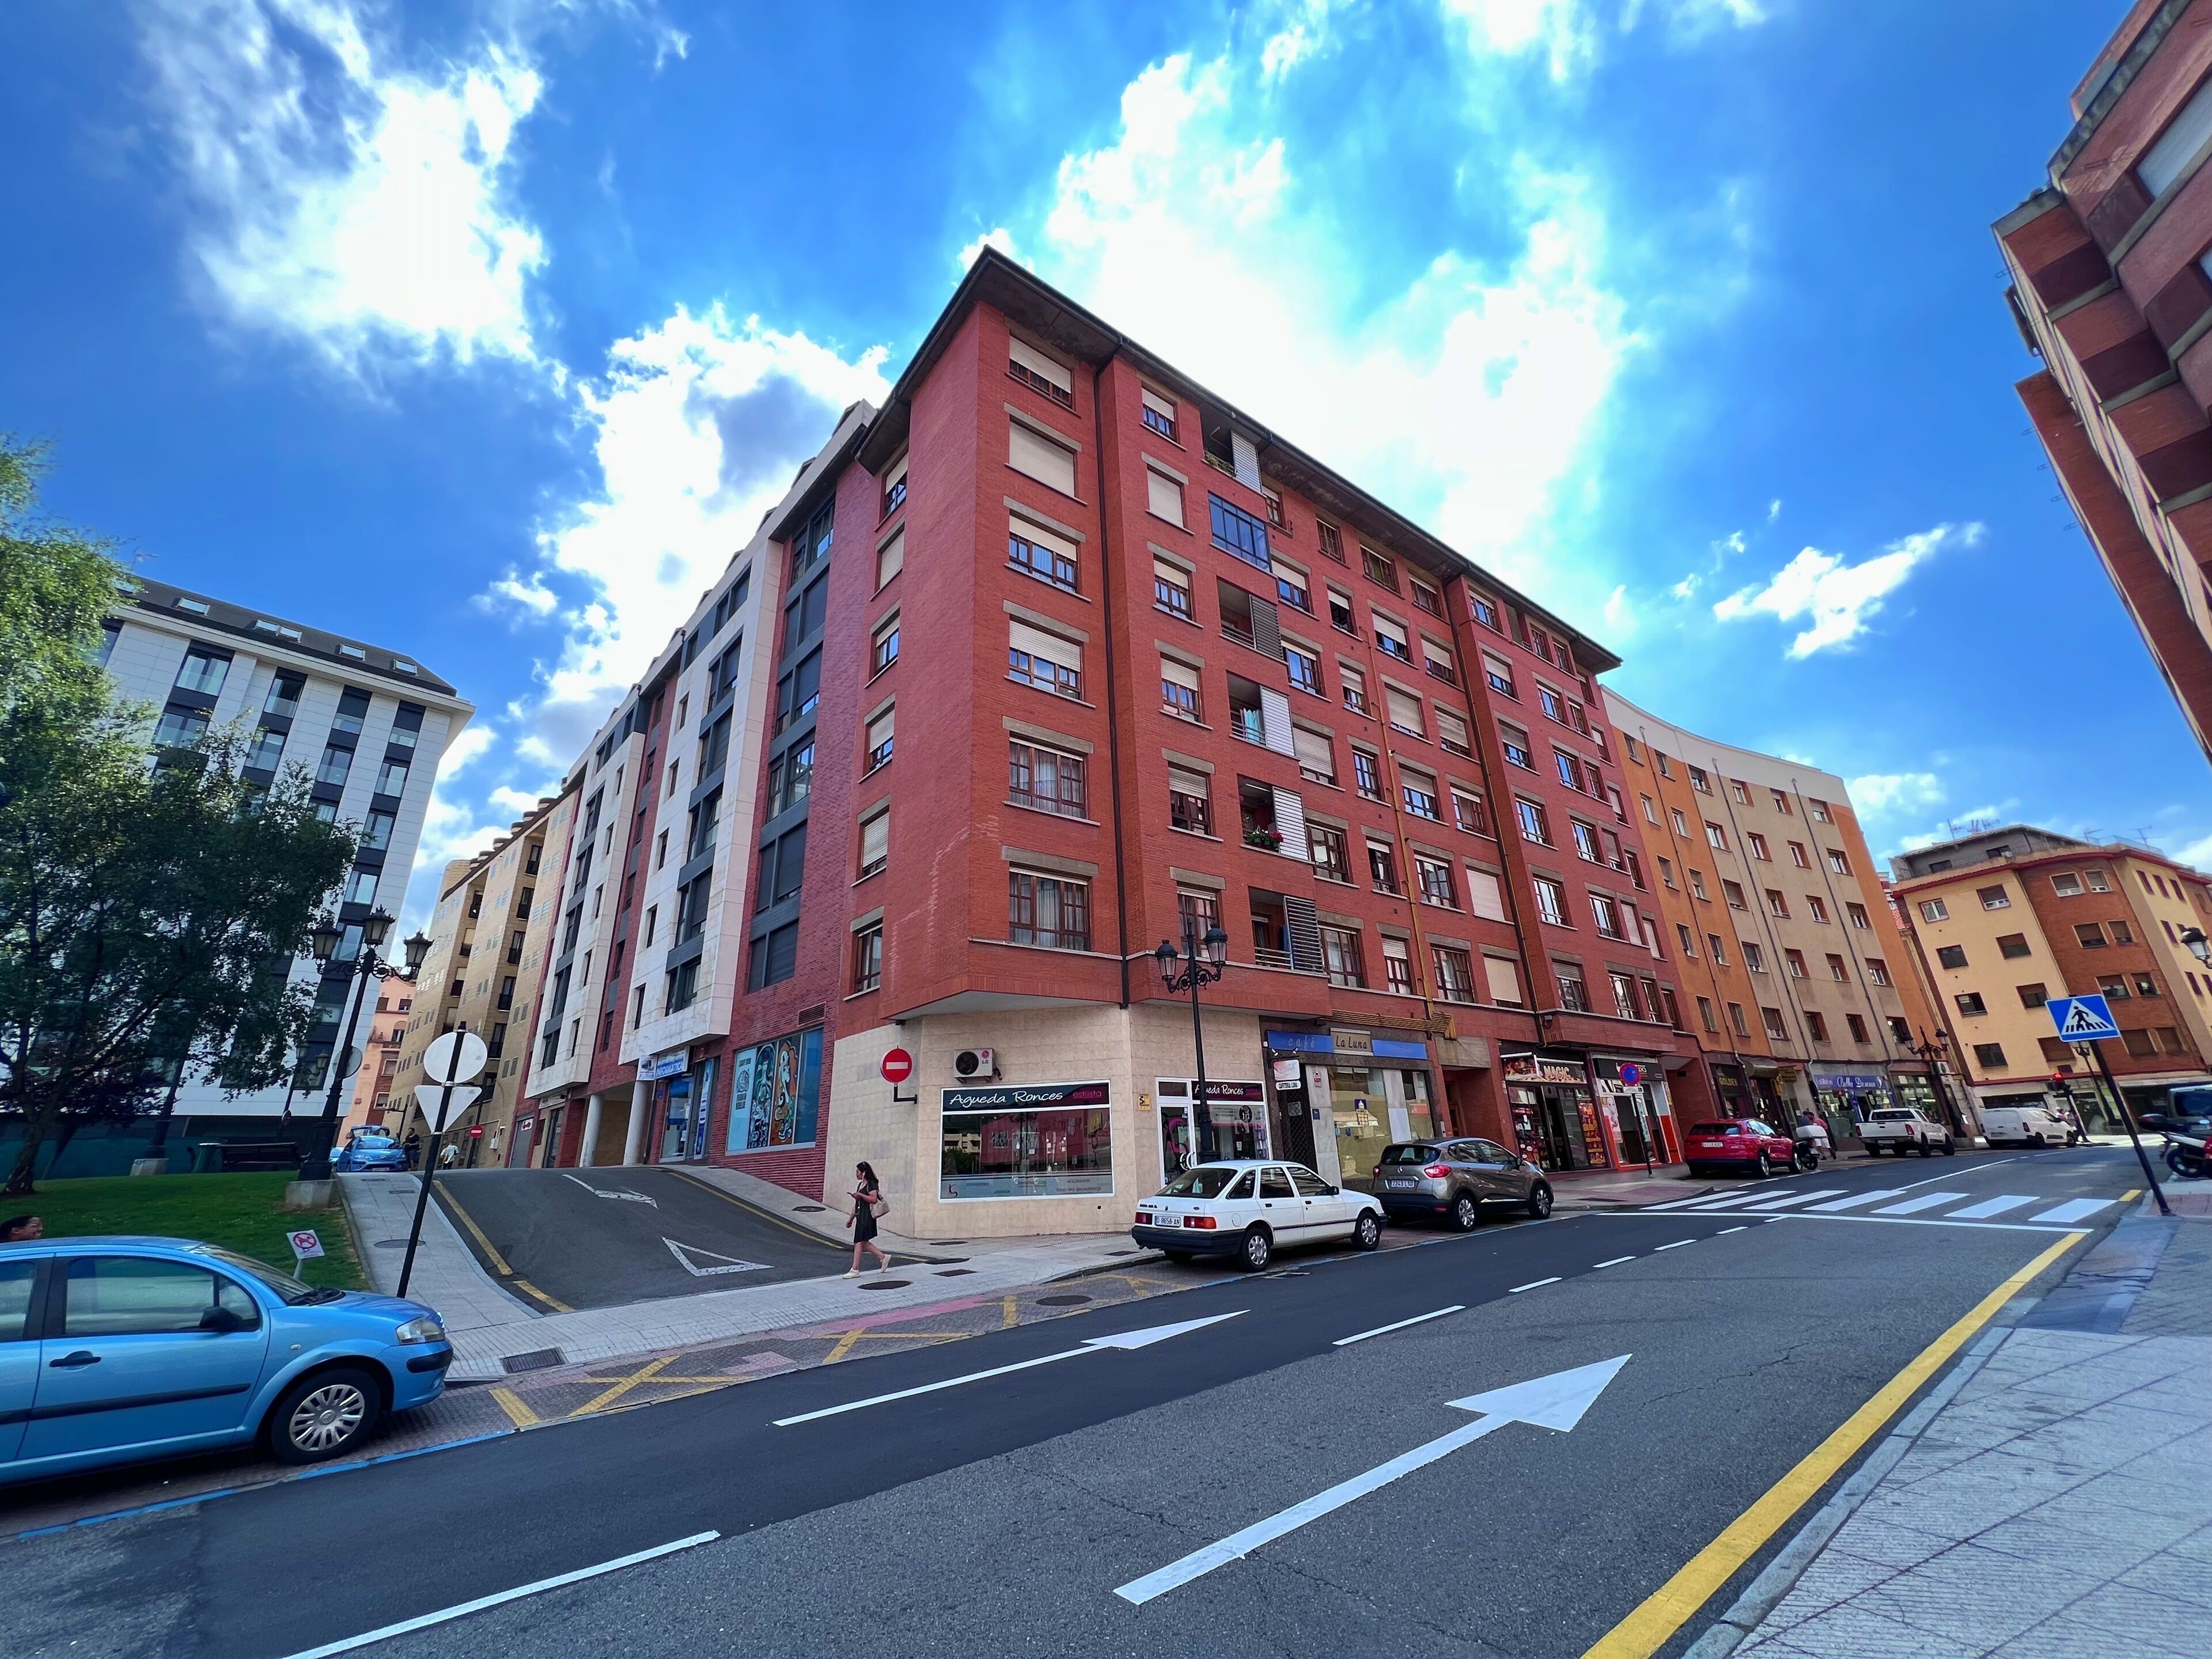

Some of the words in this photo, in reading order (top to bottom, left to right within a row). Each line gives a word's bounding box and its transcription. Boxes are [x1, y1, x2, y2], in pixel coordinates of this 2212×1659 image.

[1336, 1035, 1346, 1047] La
[1349, 1036, 1368, 1049] Luna
[1544, 1065, 1571, 1080] MAGIC
[1221, 1084, 1244, 1095] Ronces
[949, 1094, 1006, 1108] Agueda
[1012, 1090, 1063, 1102] Ronces
